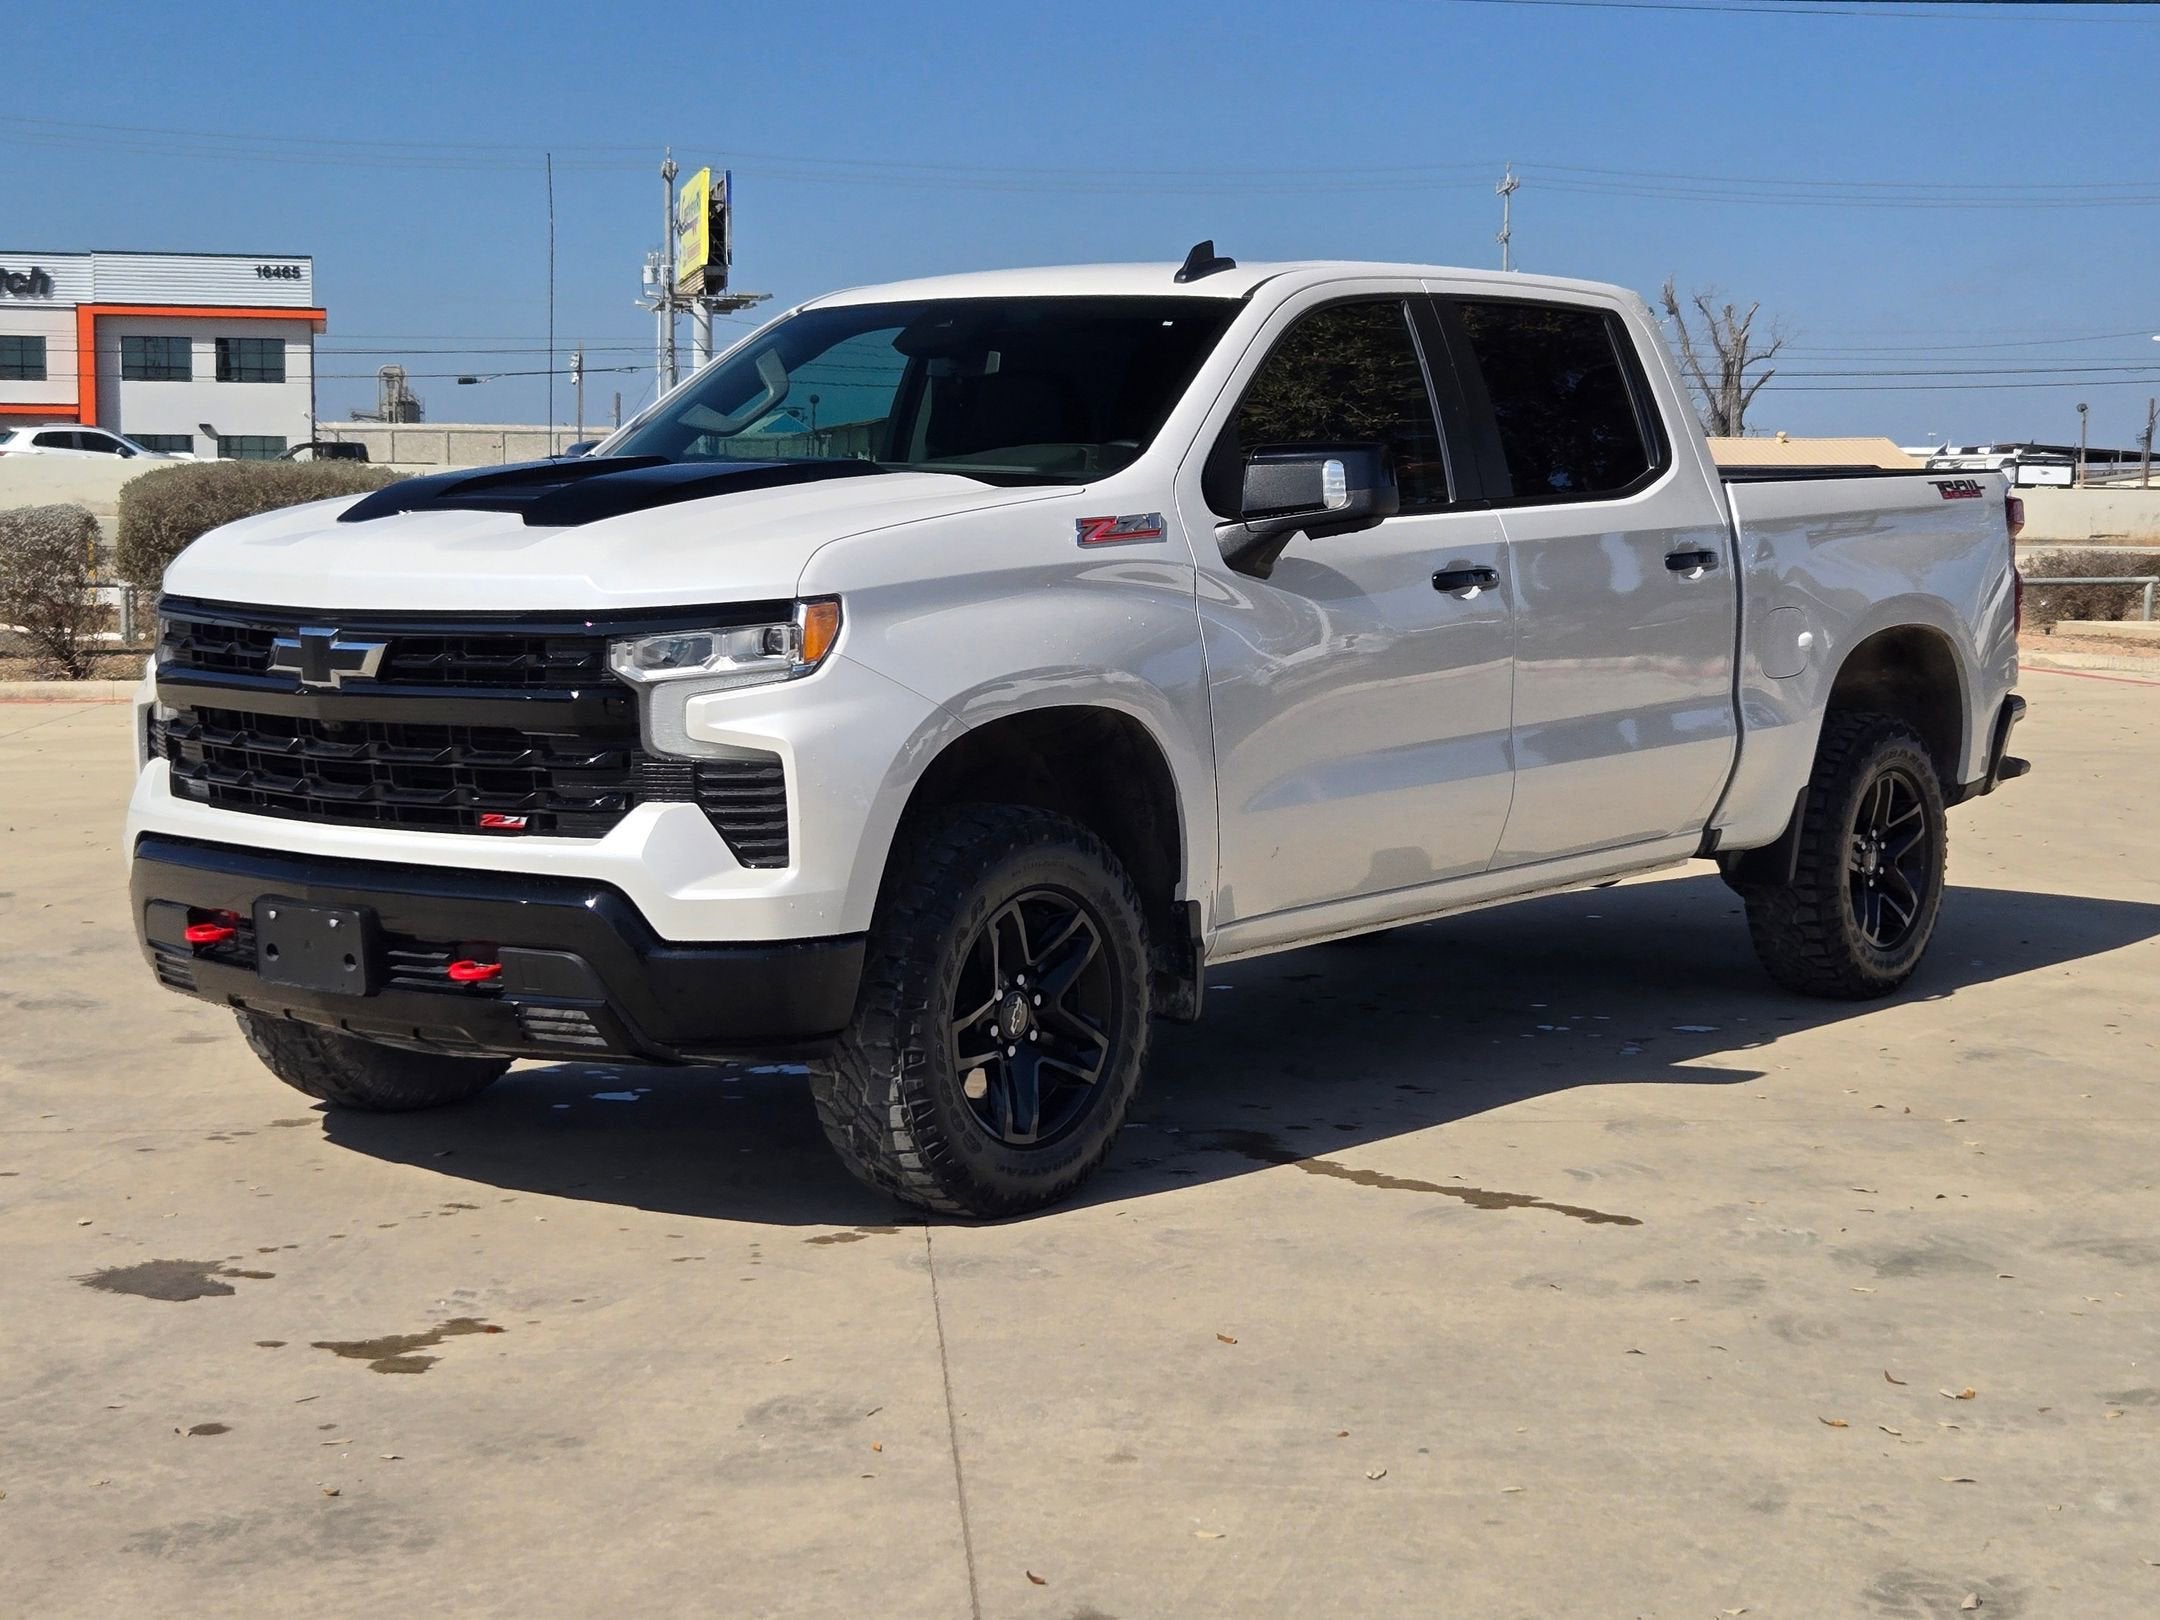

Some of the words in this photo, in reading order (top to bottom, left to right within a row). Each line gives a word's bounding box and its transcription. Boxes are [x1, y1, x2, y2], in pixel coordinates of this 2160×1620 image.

[256, 264, 301, 279] 16465
[1928, 479, 1985, 492] TRAIL
[1941, 489, 1983, 500] BOSS
[1076, 512, 1163, 546] Z71
[480, 813, 529, 829] Z71
